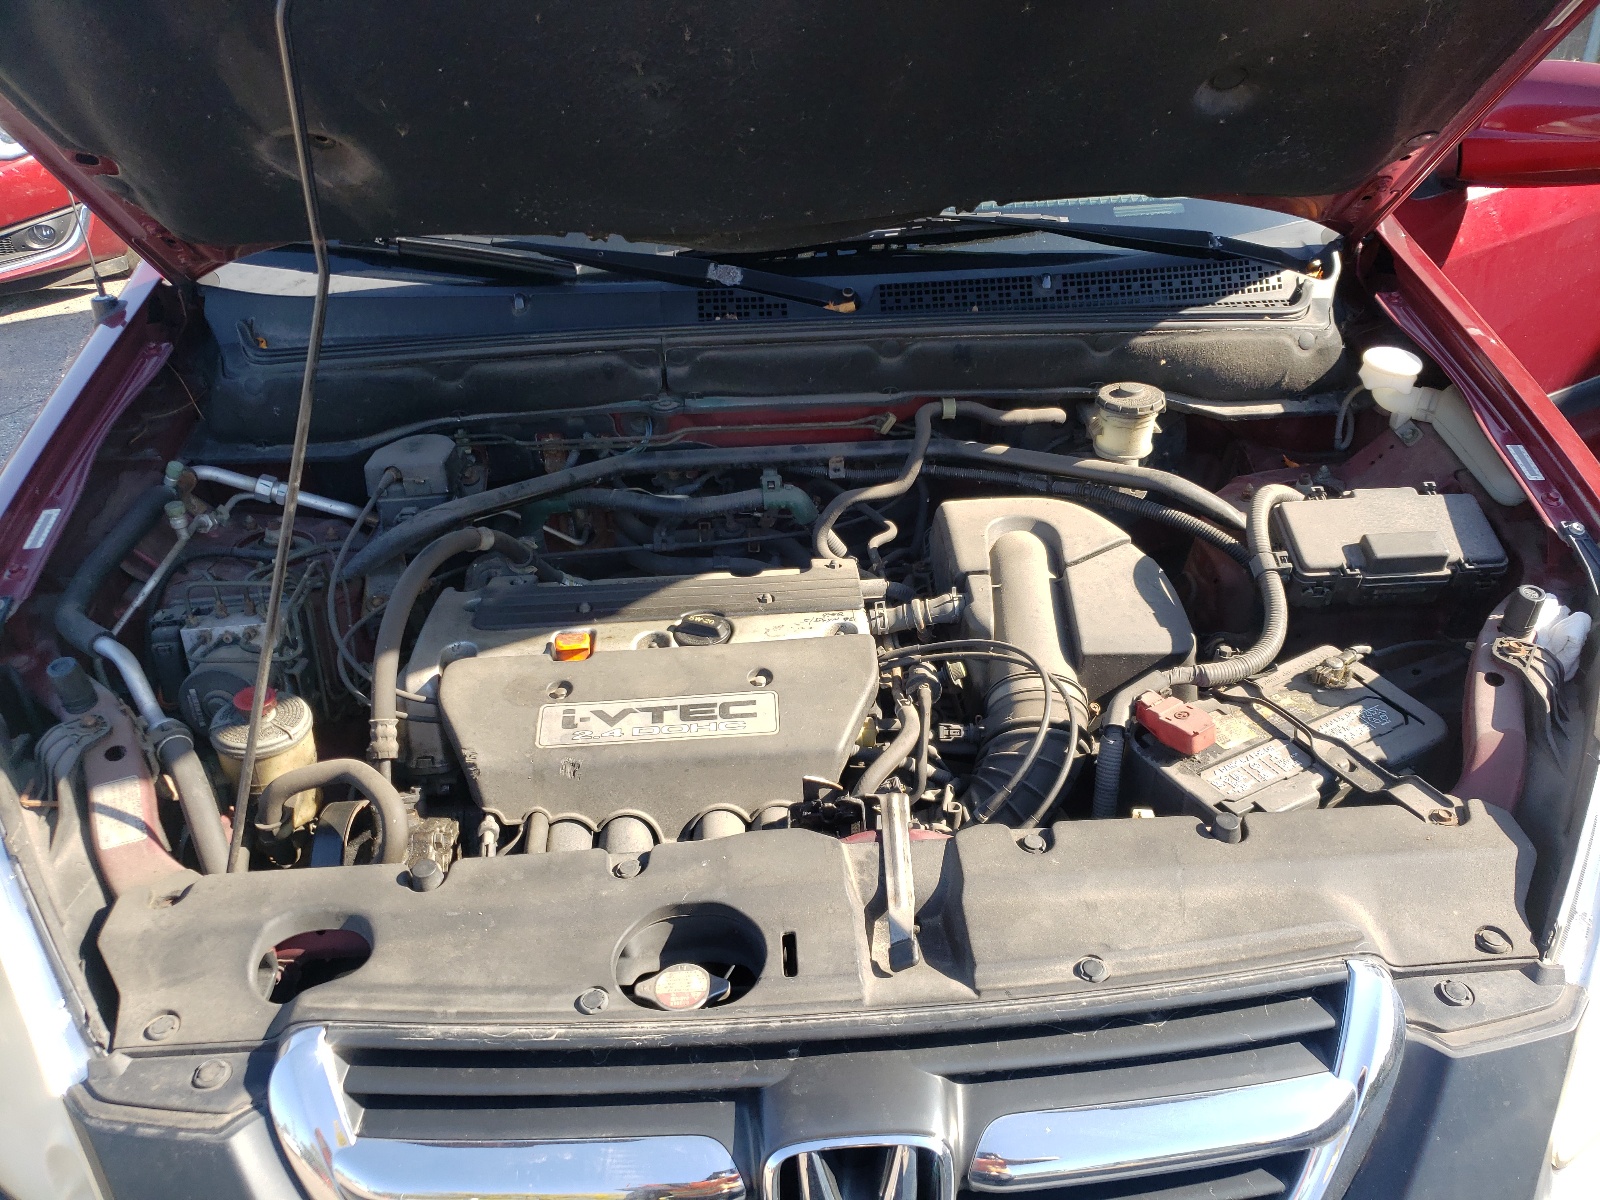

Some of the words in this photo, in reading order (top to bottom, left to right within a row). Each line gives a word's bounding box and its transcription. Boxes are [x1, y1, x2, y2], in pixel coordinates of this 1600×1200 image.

[561, 700, 757, 729] i-VTEC
[571, 727, 624, 740] 2.4
[631, 720, 747, 736] DOHC
